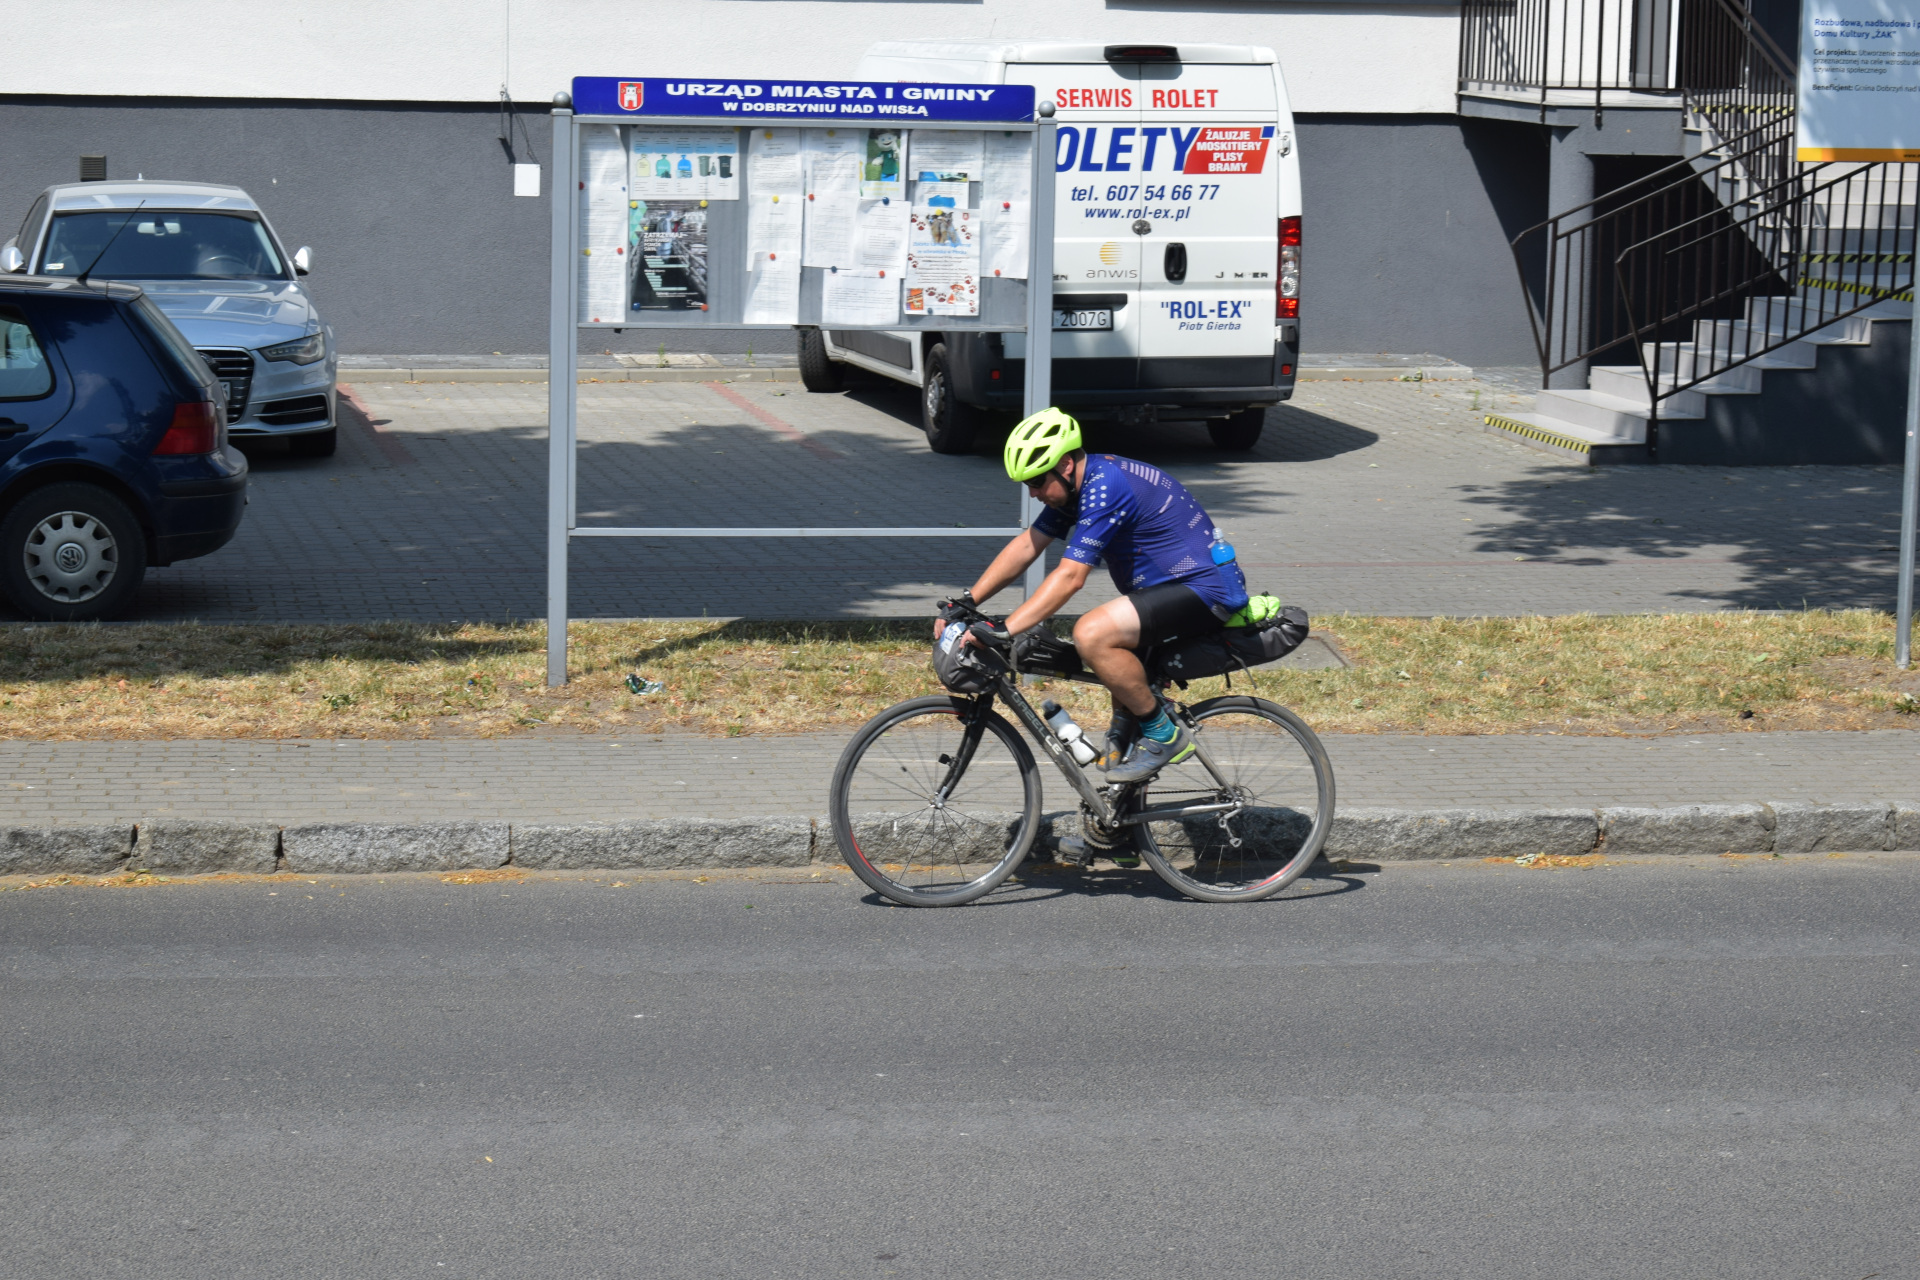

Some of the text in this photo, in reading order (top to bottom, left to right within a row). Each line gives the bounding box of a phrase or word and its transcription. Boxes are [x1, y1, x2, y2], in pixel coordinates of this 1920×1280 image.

[1814, 18, 1863, 28] Rozbudowa,
[1864, 19, 1911, 28] nadbudowa
[1814, 29, 1838, 38] Domu
[1839, 30, 1870, 40] Kultury
[1813, 48, 1825, 56] Cel
[666, 83, 996, 102] URZĄD MIASTA I GMINY
[1056, 88, 1219, 109] SERWIS ROLET
[722, 102, 929, 117] W DOBRZYNIU NAD WISŁĄ
[1205, 128, 1251, 141] ŻALUZJE
[1056, 126, 1201, 173] OLETY
[1196, 141, 1263, 152] MOSKITIERY
[1213, 152, 1244, 162] PLISY
[1208, 162, 1248, 173] BRAMY
[1071, 184, 1221, 202] tel. 607 54 66 77
[1085, 206, 1191, 222] www.rol-ex.pl
[1086, 268, 1138, 279] anwis
[1160, 300, 1251, 319] "ROL-EX"
[1178, 321, 1242, 331] Piotr Gierba
